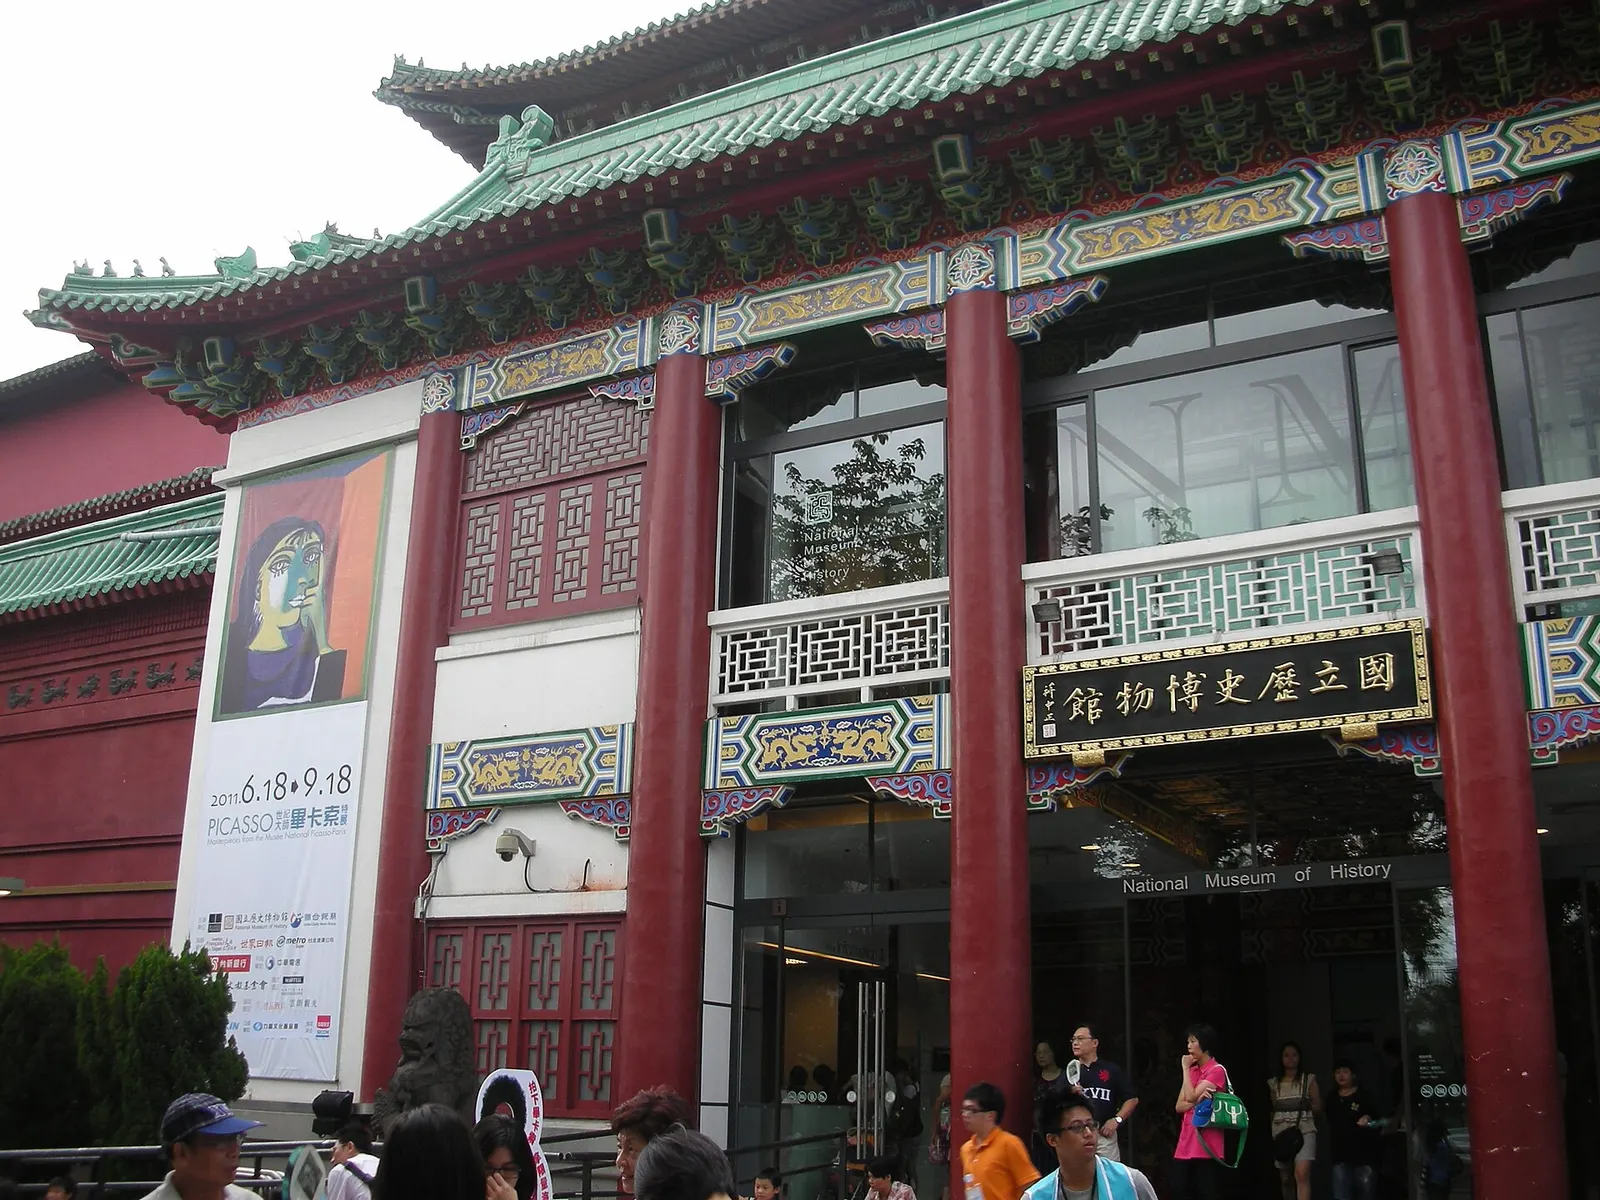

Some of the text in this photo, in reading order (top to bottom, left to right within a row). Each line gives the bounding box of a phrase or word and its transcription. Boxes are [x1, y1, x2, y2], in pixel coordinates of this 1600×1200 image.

[804, 525, 858, 542] National
[804, 541, 857, 555] Museum
[304, 764, 352, 797] 9.18
[208, 813, 274, 836] PICASSO
[290, 805, 341, 830] 畢卡索
[284, 830, 309, 840] National
[1123, 862, 1392, 894] National Museum of History
[286, 936, 306, 944] metro
